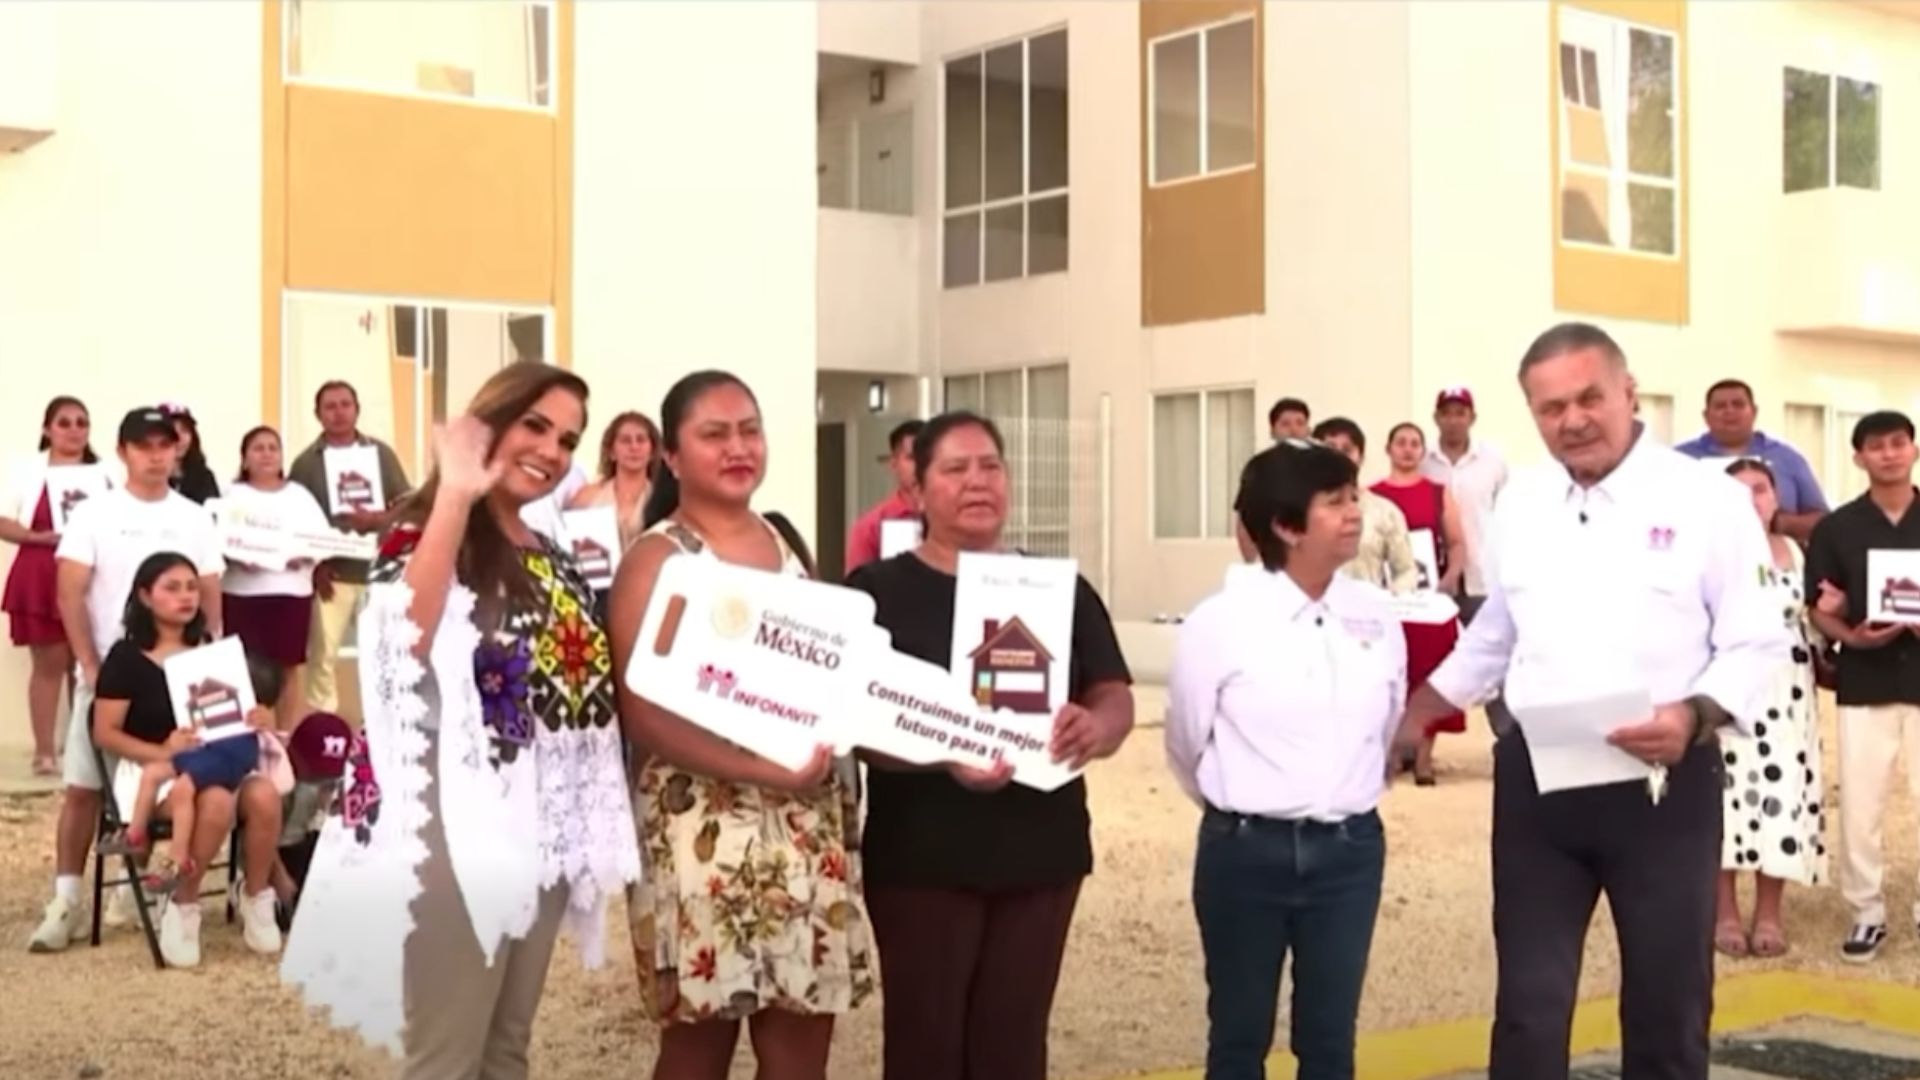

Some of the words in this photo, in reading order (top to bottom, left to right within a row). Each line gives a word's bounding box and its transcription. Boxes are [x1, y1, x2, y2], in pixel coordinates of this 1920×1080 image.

[754, 622, 840, 670] México
[762, 609, 828, 641] Gobierno
[830, 633, 847, 648] de
[733, 689, 820, 728] INFONAVIT
[867, 681, 970, 728] Construimos
[974, 719, 995, 736] un
[998, 728, 1045, 752] mejor
[895, 713, 948, 743] futuro
[949, 735, 988, 757] para
[991, 747, 1005, 761] ti
